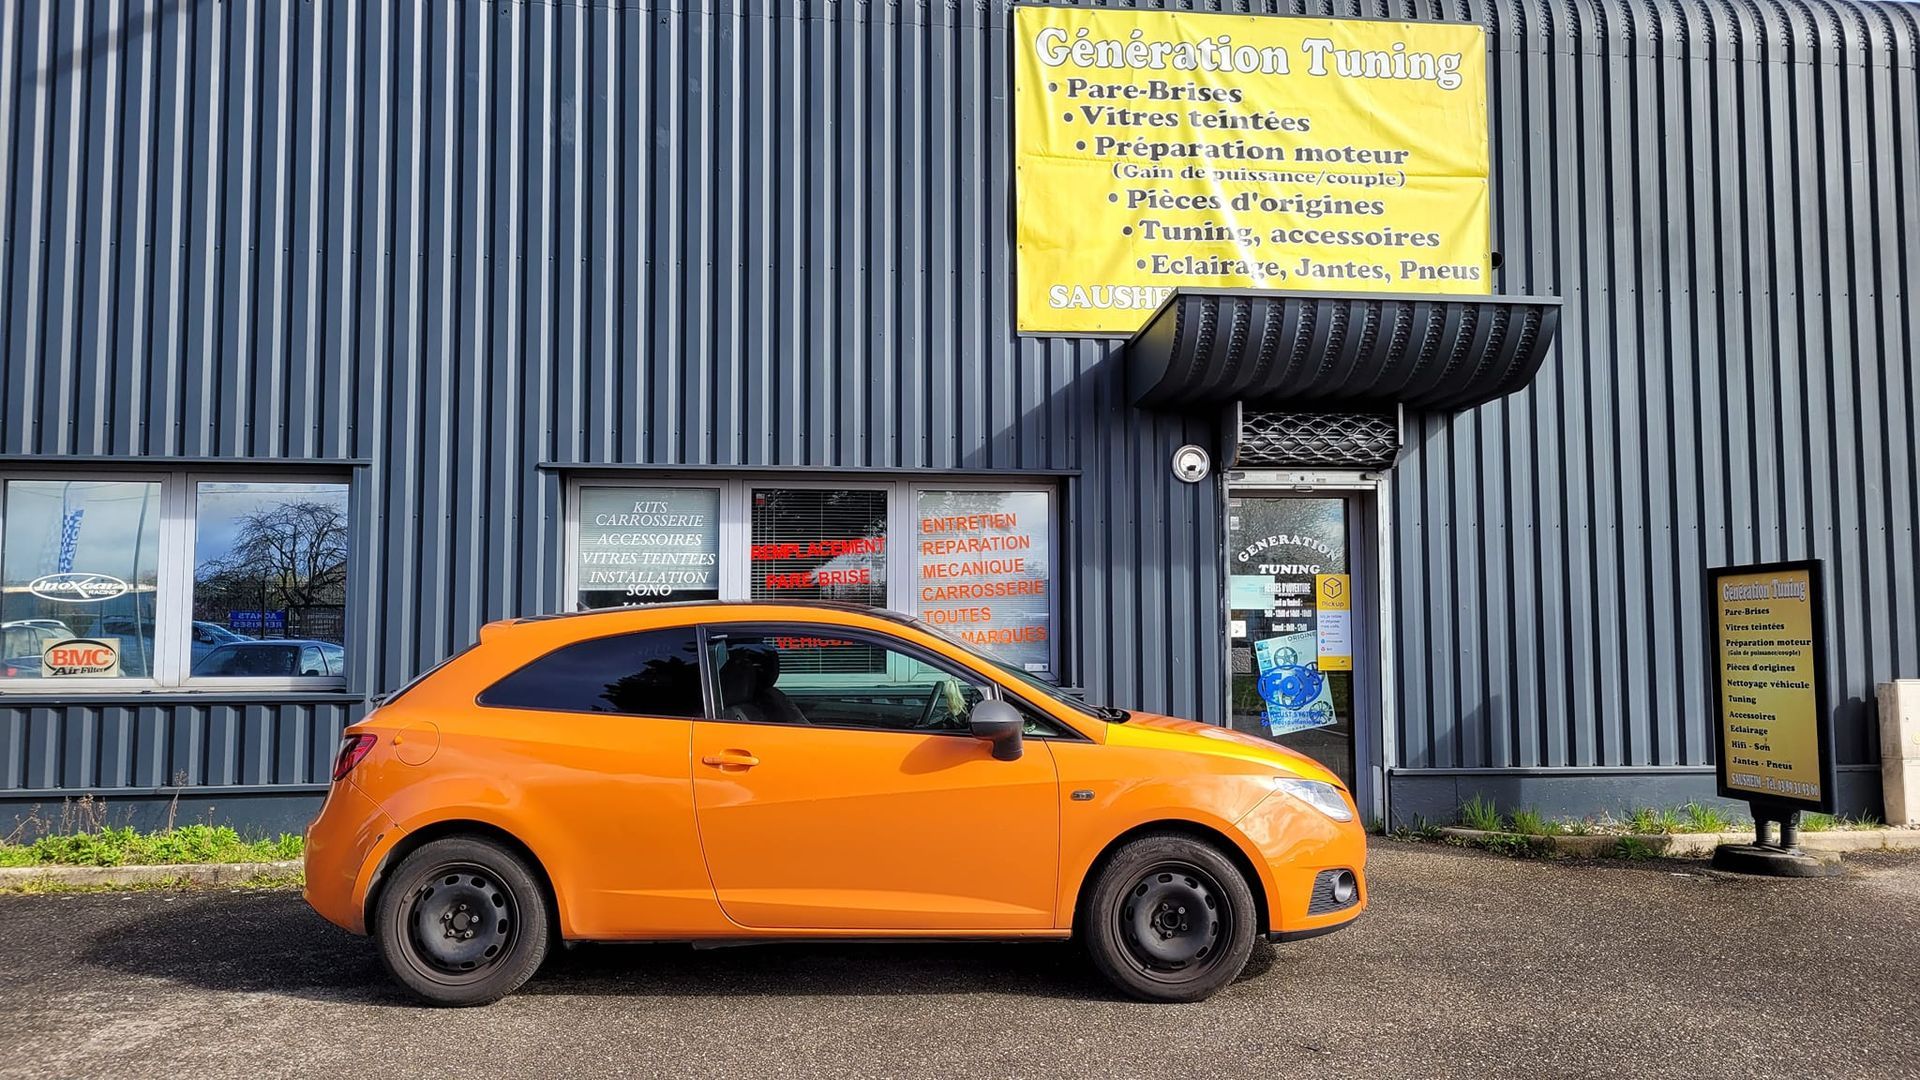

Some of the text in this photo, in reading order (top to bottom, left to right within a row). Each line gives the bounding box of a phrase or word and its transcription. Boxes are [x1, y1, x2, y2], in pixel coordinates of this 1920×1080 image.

[1035, 26, 1463, 91] Génération Tuning
[1067, 78, 1243, 104] Pare-Brises
[1084, 106, 1311, 133] Vitres teintées
[1095, 136, 1410, 165] Préparation moteur
[1113, 162, 1407, 189] (Gain de puissance/couple)
[1127, 189, 1385, 219] Pièces d'origines
[1139, 219, 1441, 248] Tuning, accessoires
[1295, 258, 1392, 284] Jantes,
[1400, 260, 1481, 281] Pneus
[1049, 285, 1176, 309] SAUSHE
[633, 501, 668, 513] KITS
[595, 514, 704, 527] CARROSSERIE
[922, 513, 1017, 533] ENTRETIEN
[597, 534, 702, 546] ACCESSOIRES
[751, 537, 885, 561] REMPLACEMENT
[922, 535, 1030, 556] REPARATION
[1238, 534, 1339, 562] GENERATION
[583, 552, 715, 565] VITRES TEINTEES
[589, 571, 708, 583] INSTALLATION
[922, 558, 1025, 579] MECANIQUE
[1258, 564, 1320, 574] TUNING
[766, 569, 870, 590] PARE BRISE
[1723, 577, 1806, 601] Génération Tuning
[626, 584, 672, 597] SONO
[922, 580, 1045, 602] CARROSSERIE
[924, 606, 991, 625] TOUTES
[1725, 607, 1770, 616] Pare-Brises
[961, 625, 1046, 645] MARQUES
[1725, 622, 1785, 631] Vitres teintées
[1726, 639, 1774, 648] Préparation
[51, 649, 110, 667] BMC
[1727, 663, 1795, 672] Pièces d'origines
[52, 666, 105, 676] Air Filter
[1727, 679, 1810, 689] Nettoyage véhicule
[1728, 695, 1757, 705] Tuning
[1729, 711, 1776, 721] Accessoires
[1730, 725, 1768, 736] Eclairage
[1733, 756, 1759, 767] Jantes
[1766, 760, 1793, 770] Pneus
